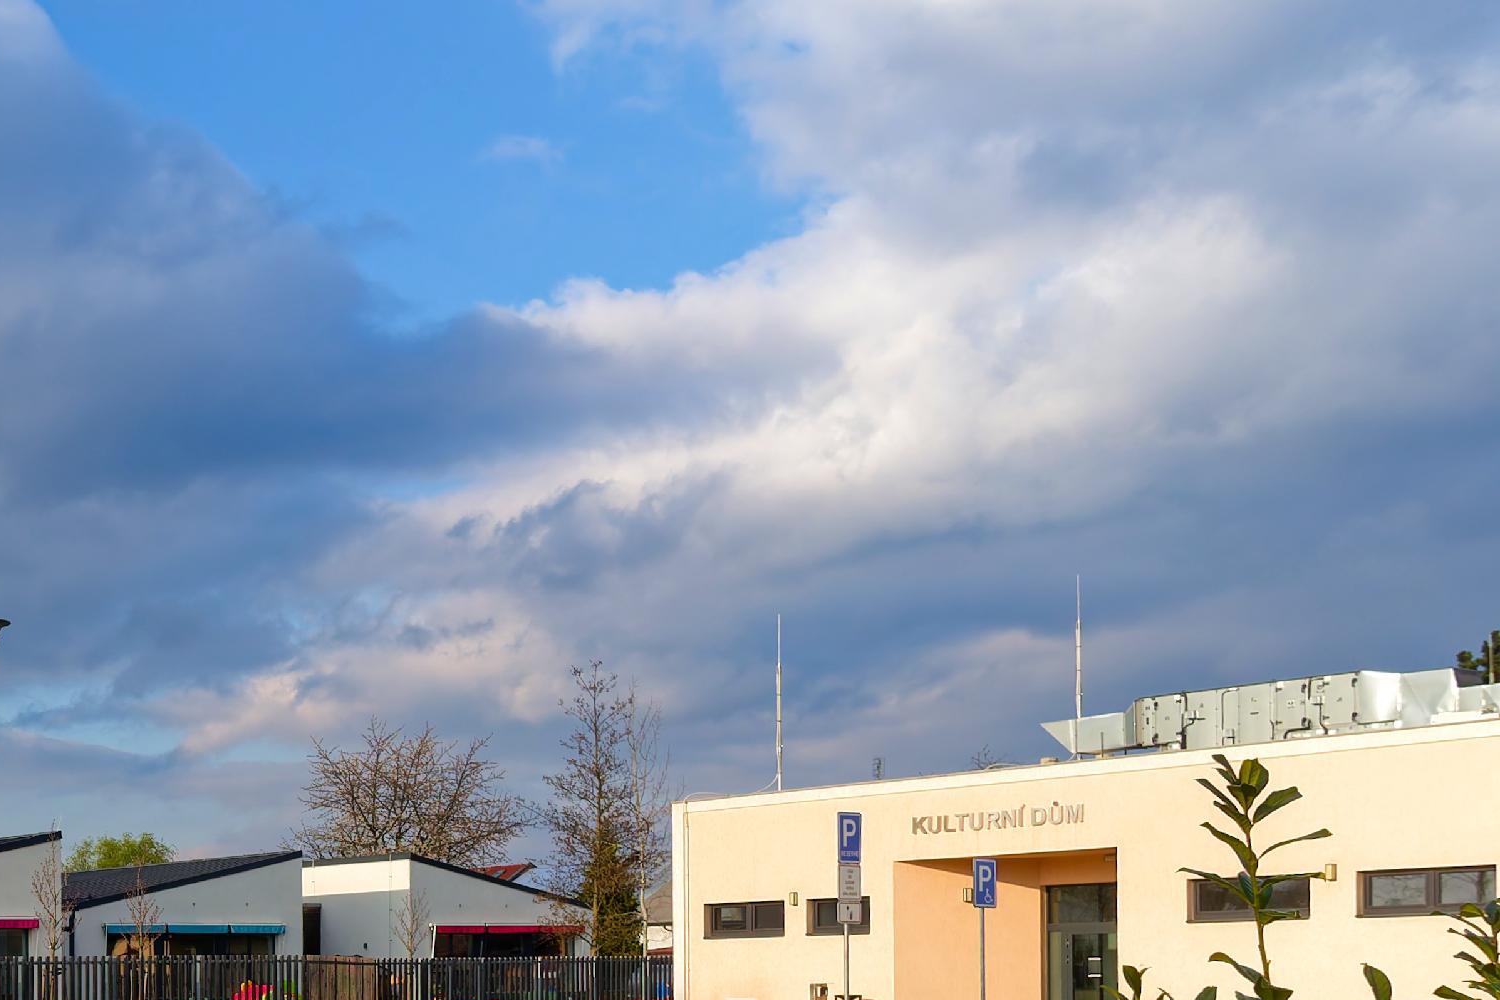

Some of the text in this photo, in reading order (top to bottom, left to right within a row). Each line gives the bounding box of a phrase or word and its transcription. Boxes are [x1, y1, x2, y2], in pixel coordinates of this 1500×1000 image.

[842, 818, 856, 848] P
[911, 801, 1085, 835] KULTURNÍ DŮM
[978, 865, 992, 892] P
